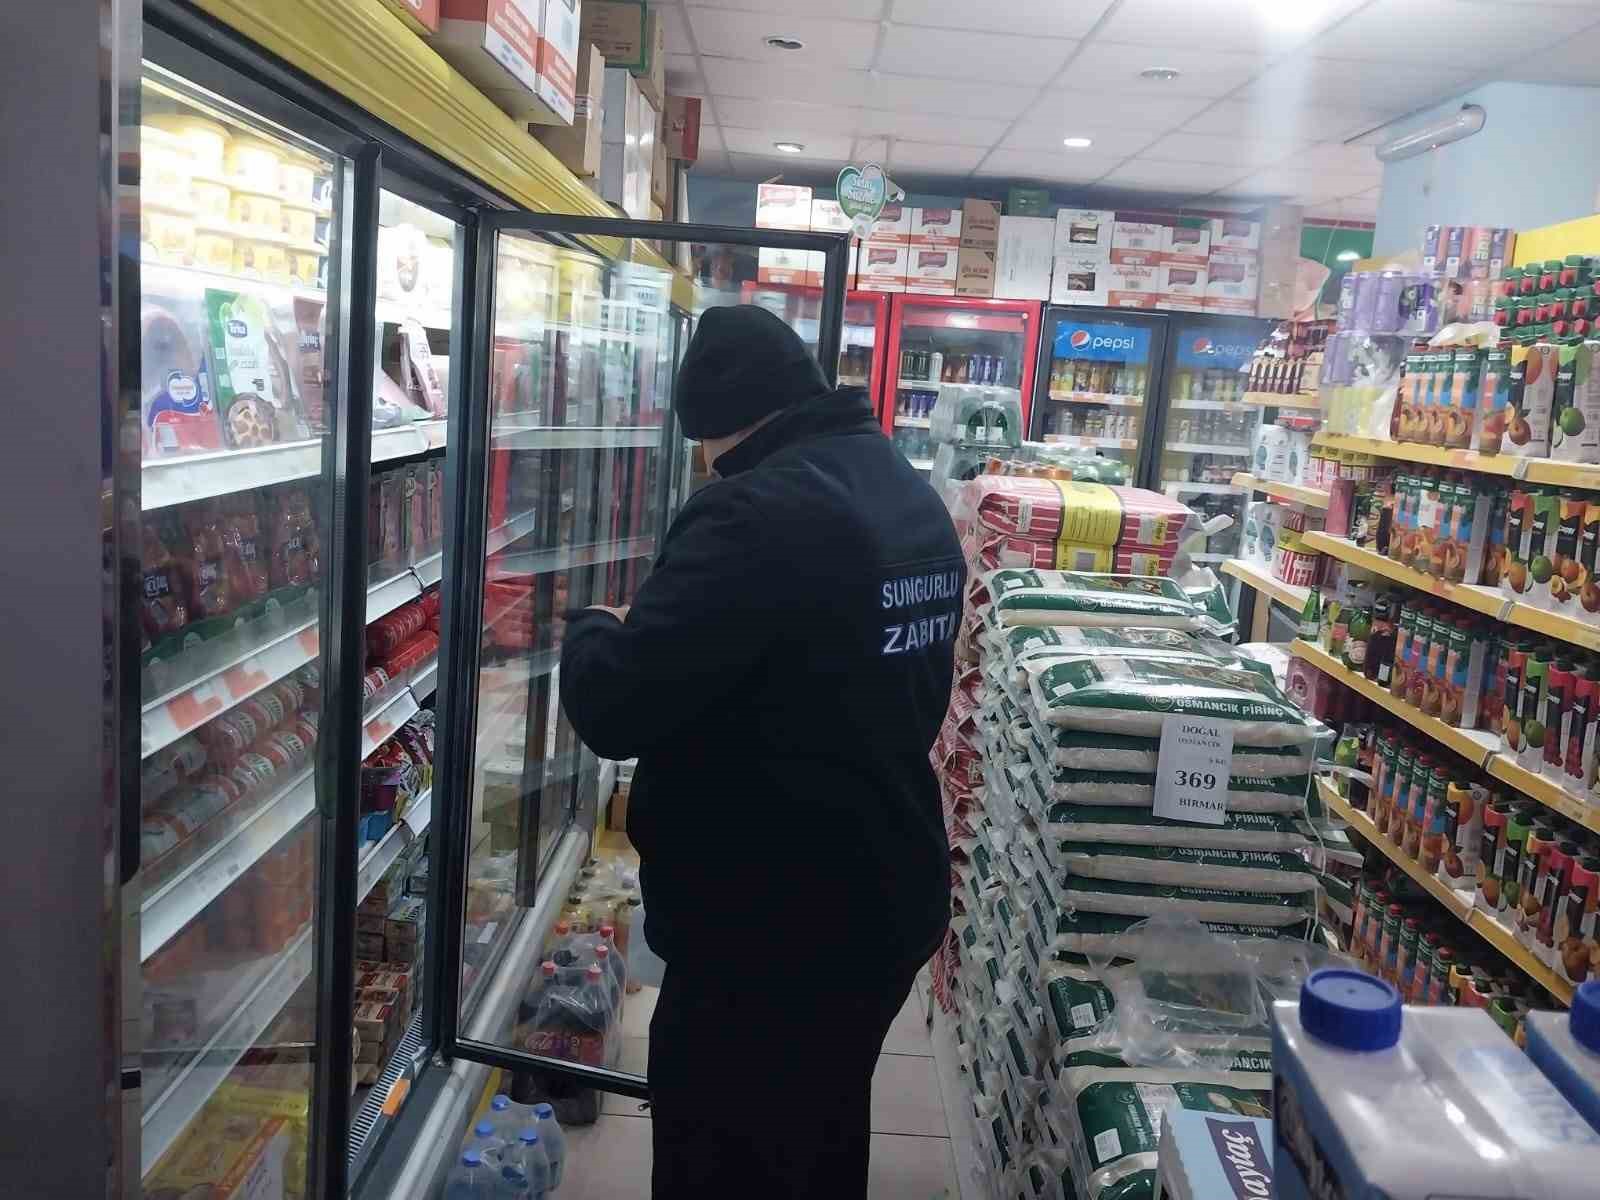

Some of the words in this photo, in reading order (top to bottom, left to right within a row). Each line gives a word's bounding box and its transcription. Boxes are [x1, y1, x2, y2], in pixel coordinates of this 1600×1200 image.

[1092, 335, 1135, 350] pepsi
[882, 571, 959, 609] SUNGURLU
[1176, 699, 1240, 714] OSMANCIK
[1242, 703, 1284, 718] PİRİNÇ
[1174, 770, 1217, 790] 369
